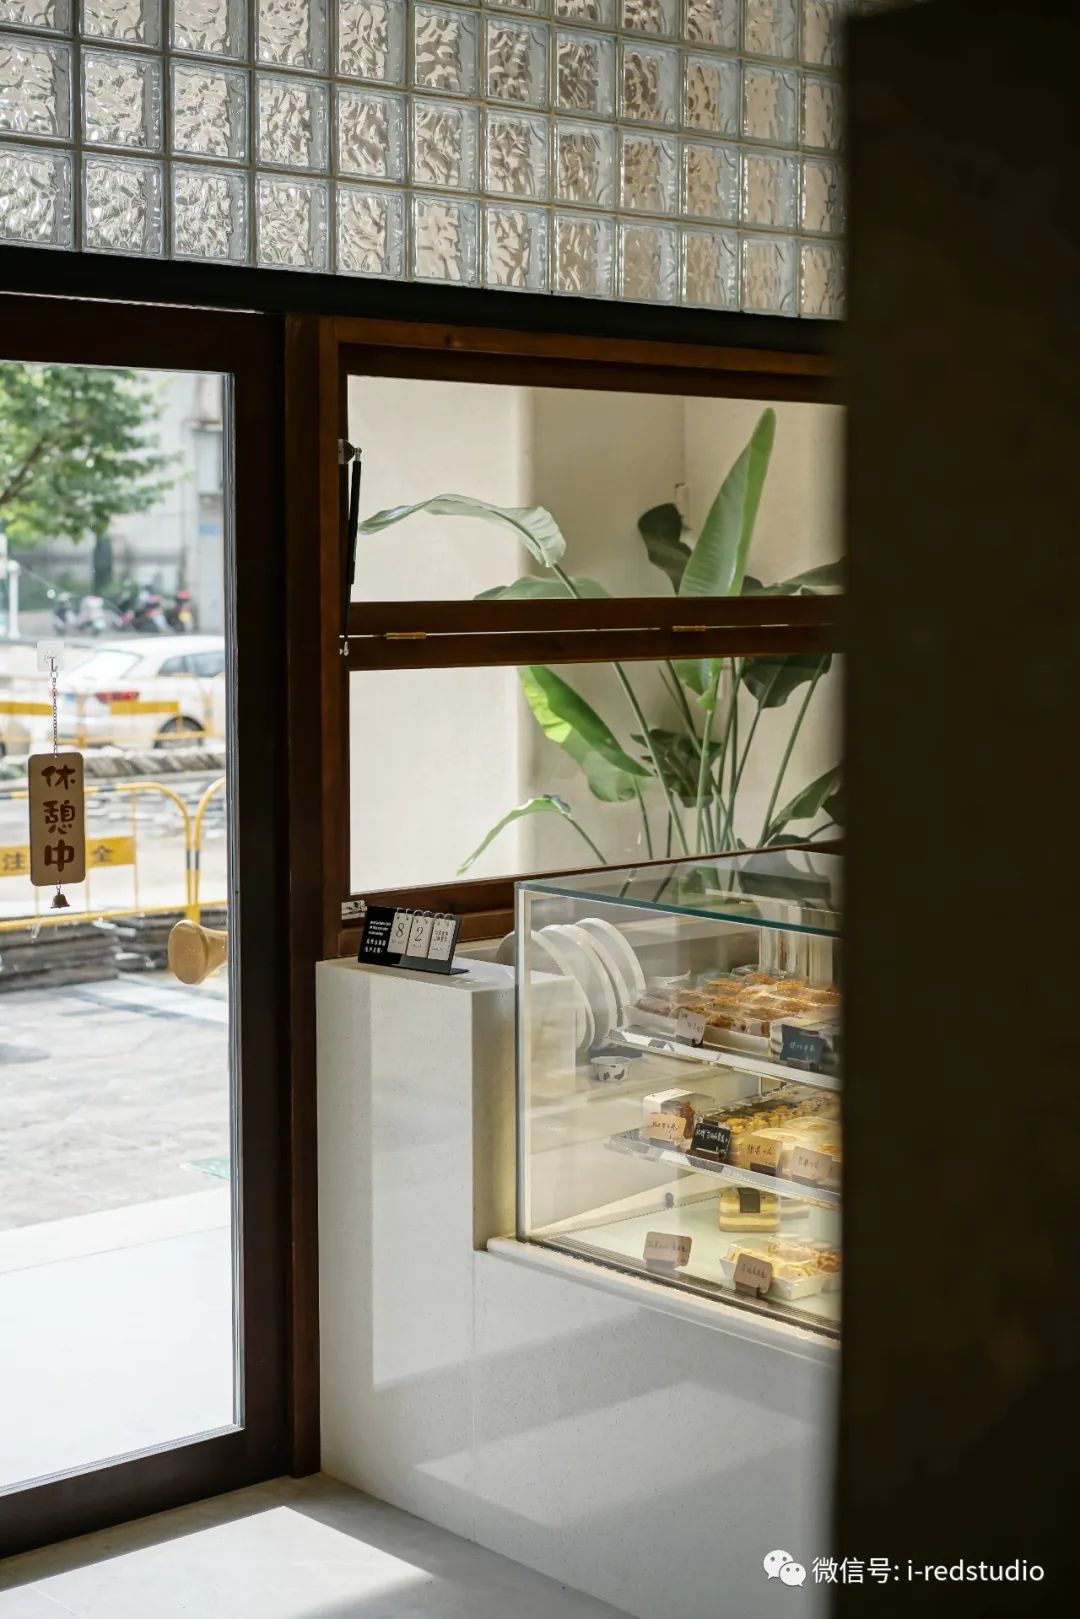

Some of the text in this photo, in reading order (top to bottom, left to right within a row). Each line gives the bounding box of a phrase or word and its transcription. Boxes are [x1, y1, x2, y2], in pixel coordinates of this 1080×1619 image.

[41, 764, 76, 873] 休憩中
[395, 922, 405, 938] 8
[414, 926, 424, 942] 2
